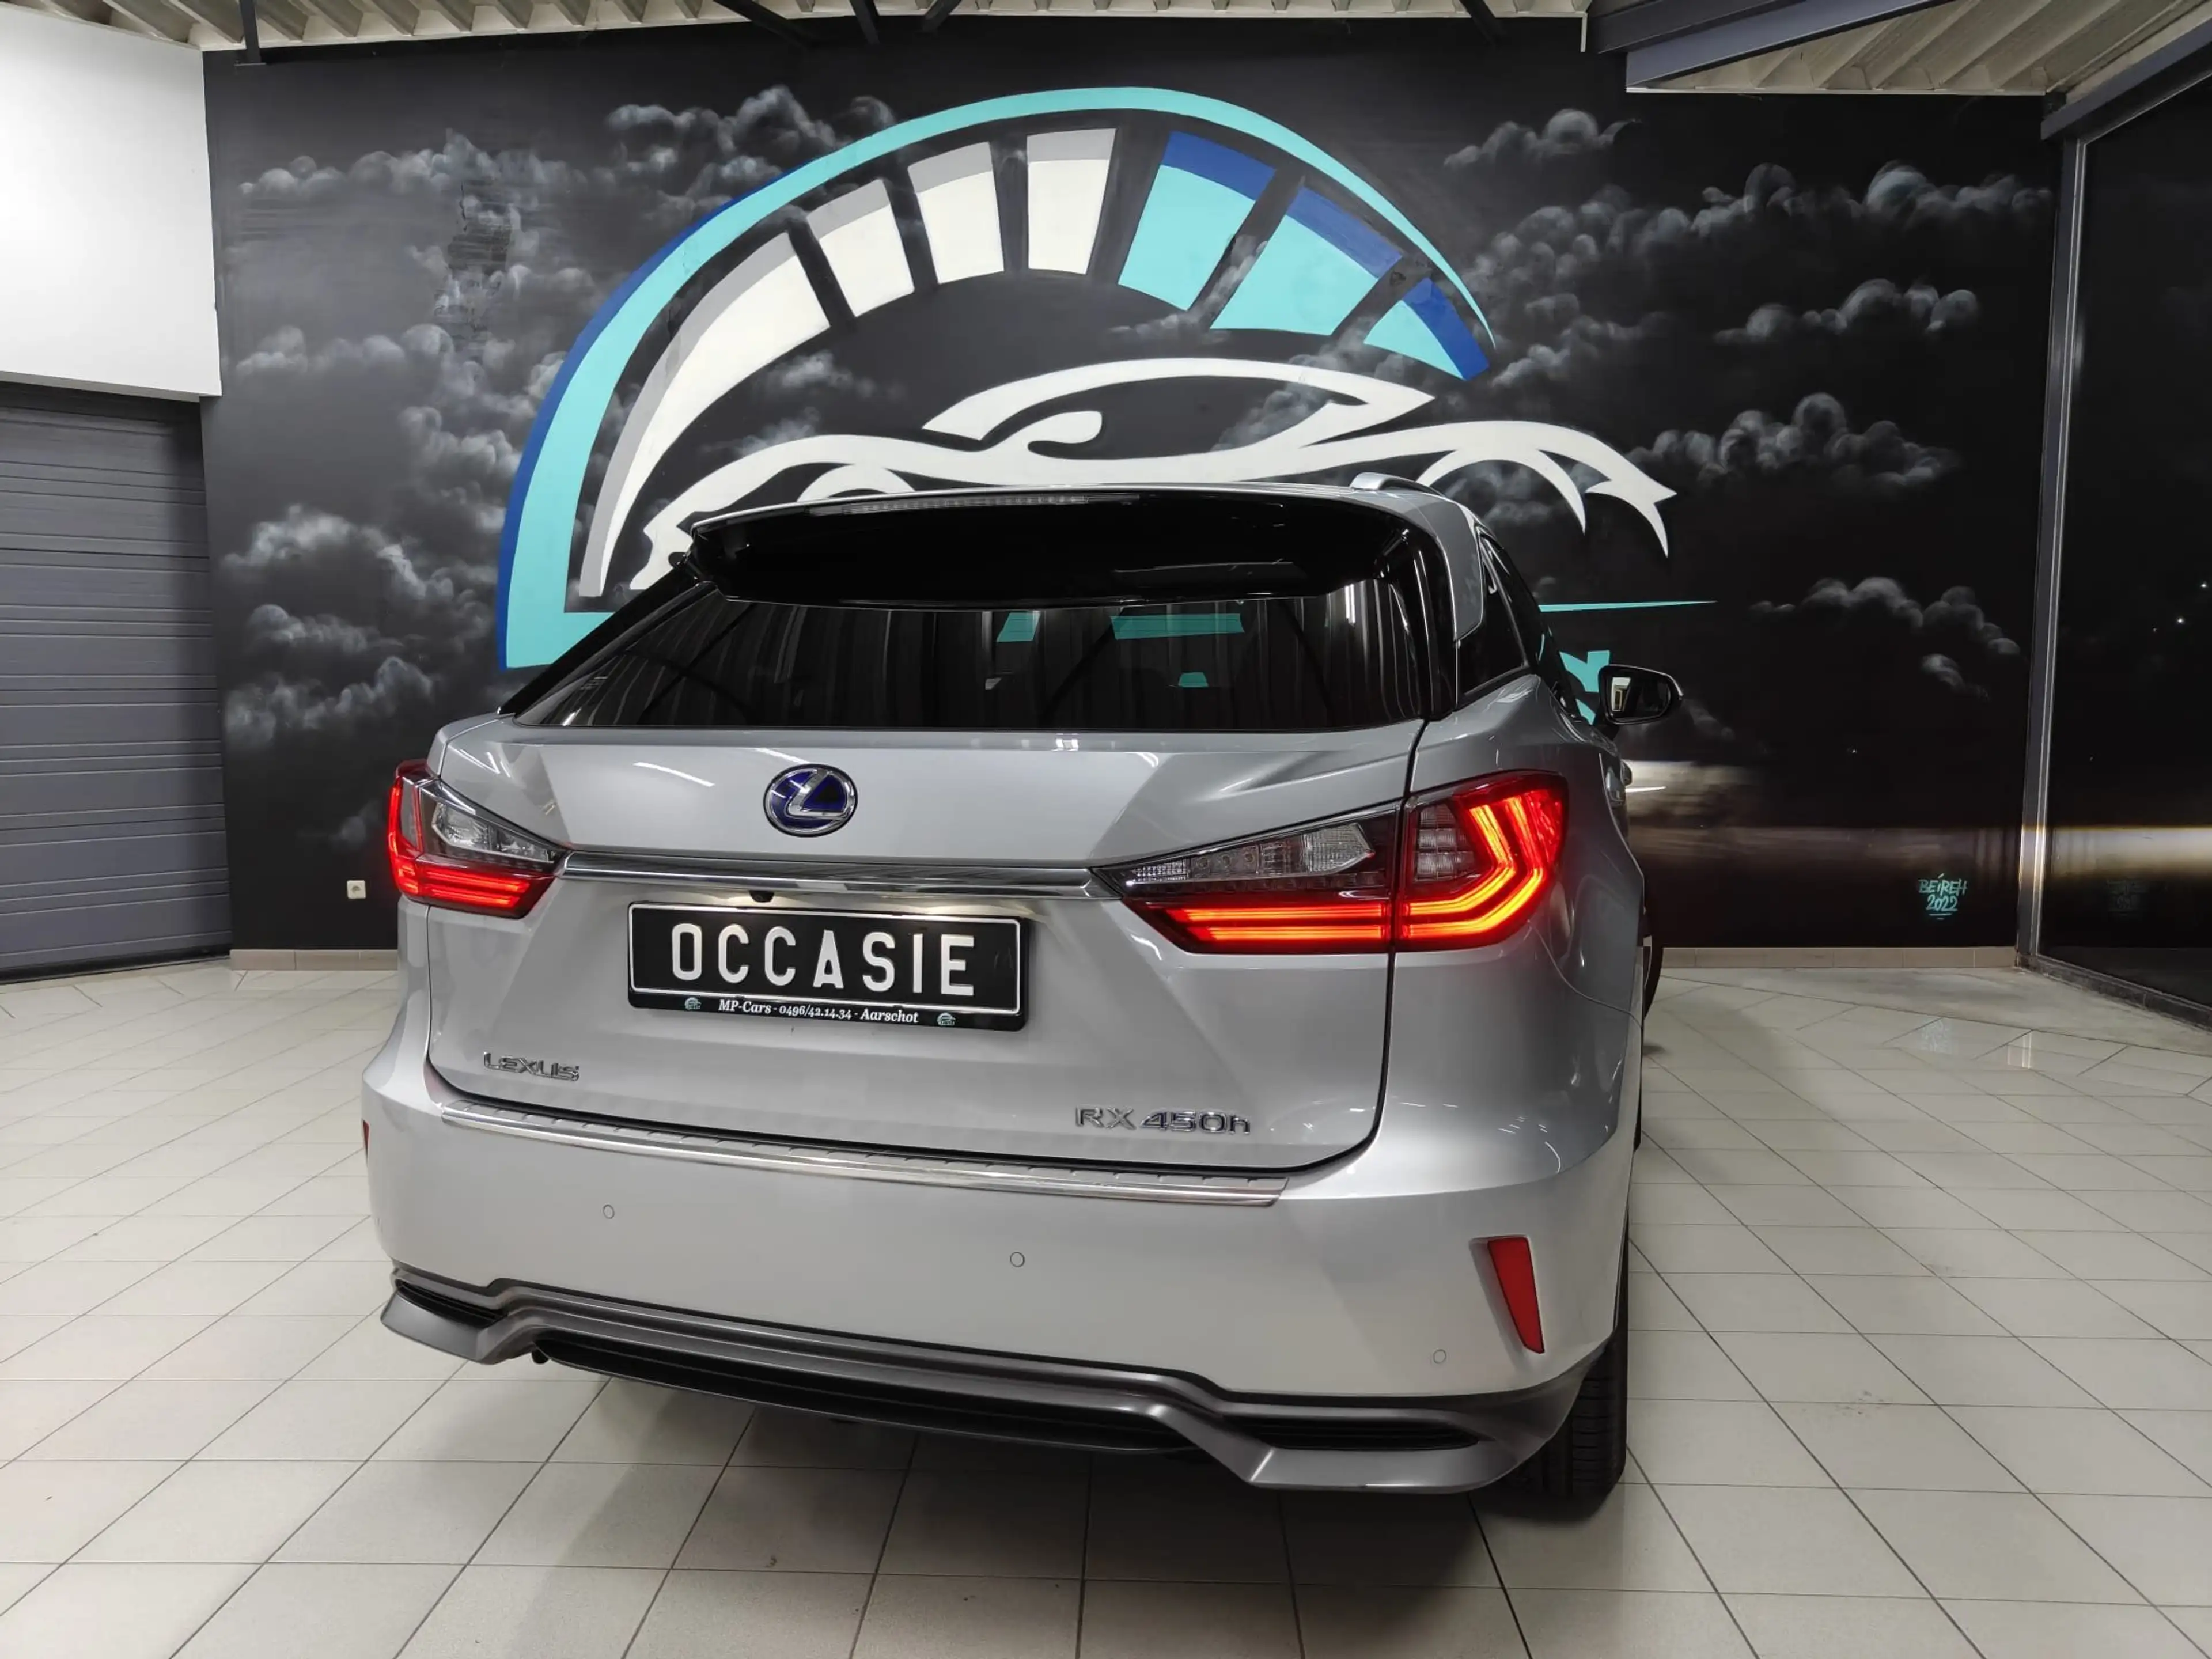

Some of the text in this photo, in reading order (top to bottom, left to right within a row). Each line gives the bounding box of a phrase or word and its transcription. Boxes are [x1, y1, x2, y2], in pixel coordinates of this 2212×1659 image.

[1926, 894, 1958, 911] 2022
[672, 923, 975, 995] OCCASIE
[718, 999, 771, 1014] MP-Cars
[779, 1004, 852, 1020] 0496/42.14.34
[860, 1008, 919, 1023] Aarschot
[484, 1051, 579, 1081] LEXUS
[1075, 1105, 1251, 1135] RX 450h
